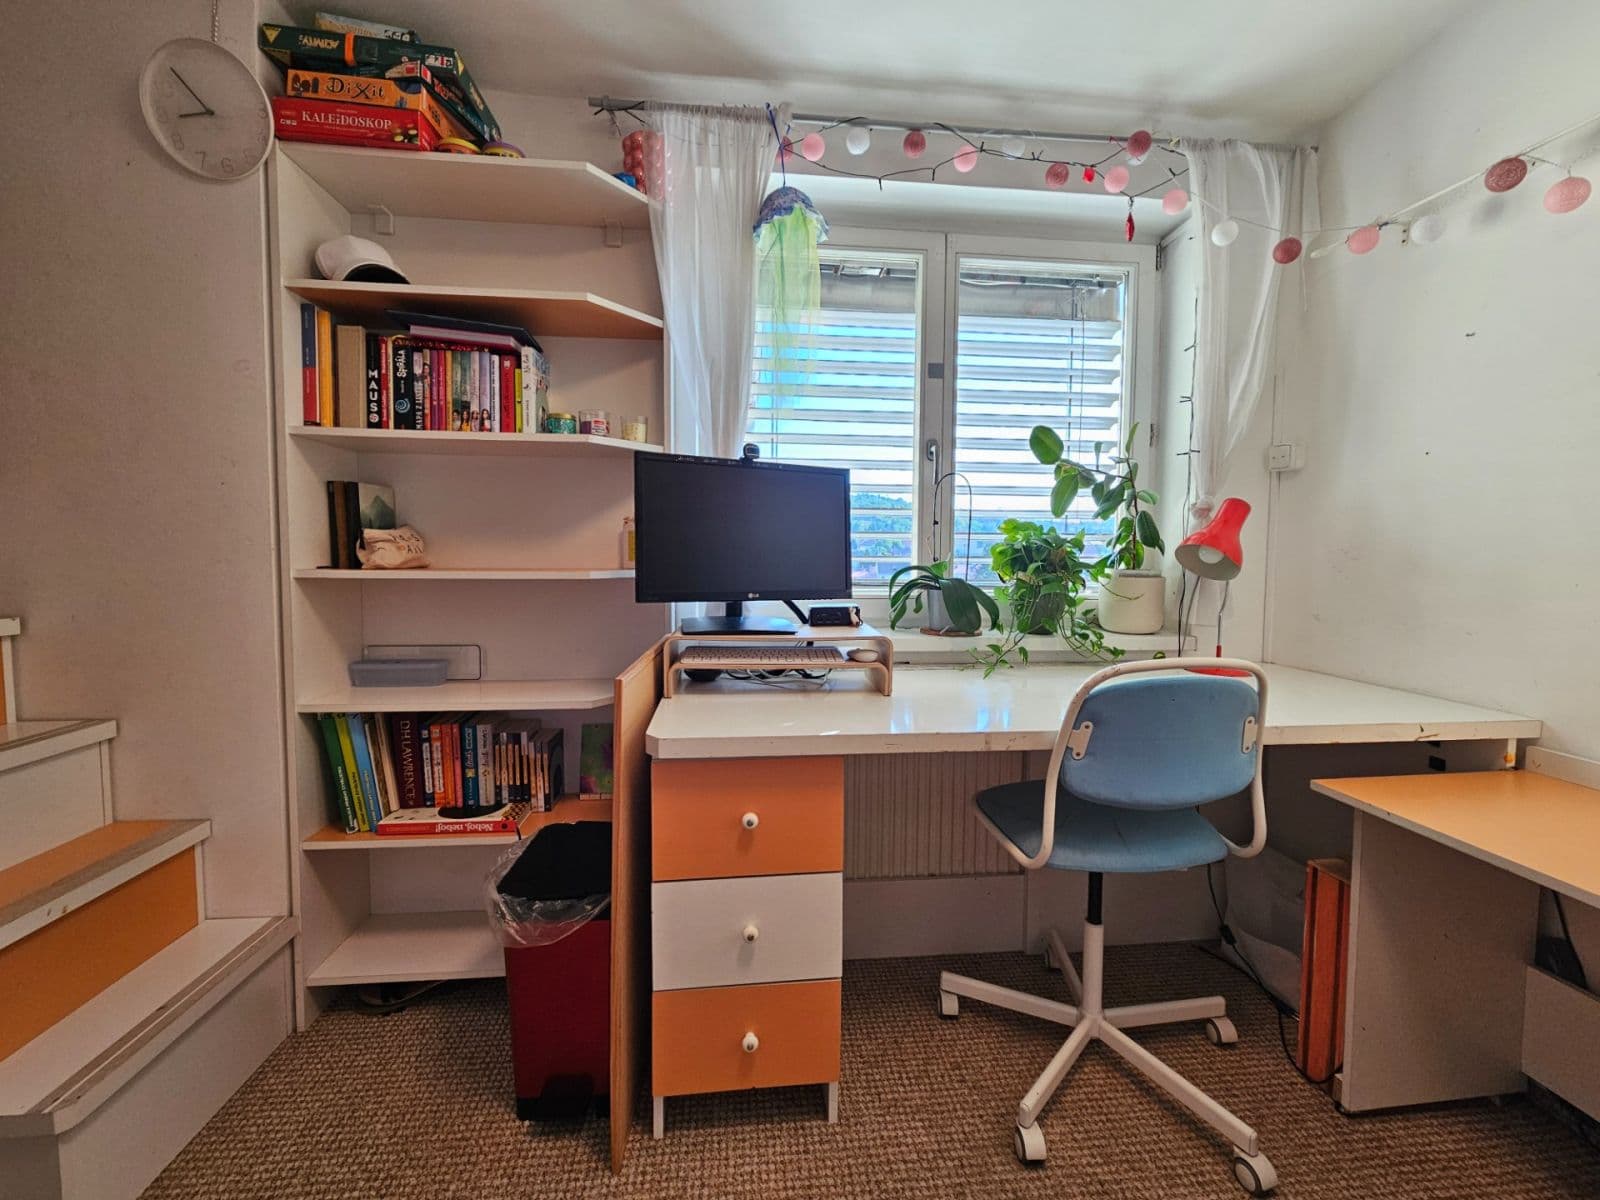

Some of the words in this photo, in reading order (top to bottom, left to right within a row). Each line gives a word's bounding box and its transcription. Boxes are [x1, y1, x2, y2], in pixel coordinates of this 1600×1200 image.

[194, 151, 207, 169] 7
[368, 369, 379, 412] MAUS
[401, 741, 416, 799] LAWRENCE
[435, 823, 464, 833] neboj!
